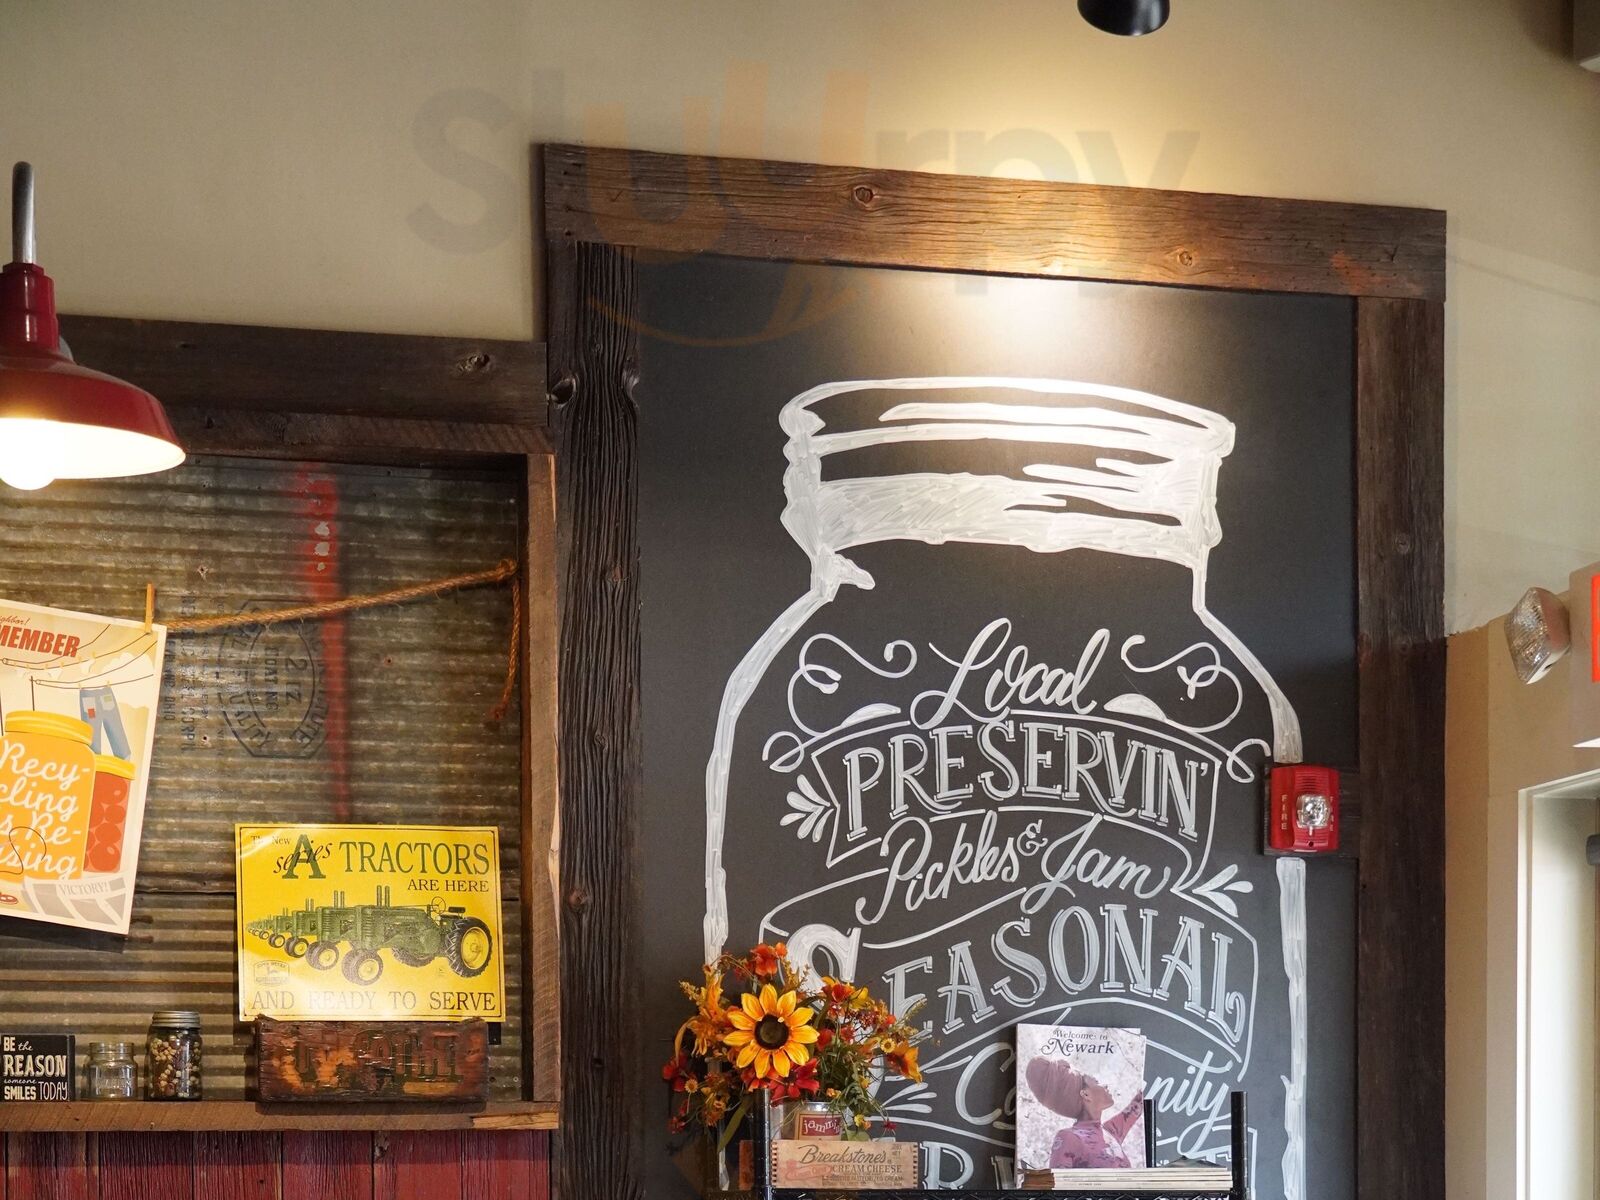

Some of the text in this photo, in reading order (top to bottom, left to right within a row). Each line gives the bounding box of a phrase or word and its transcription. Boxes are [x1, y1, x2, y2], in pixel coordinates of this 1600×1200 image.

[909, 617, 1110, 730] Local
[842, 720, 1208, 842] PRESERVIN'
[339, 841, 490, 875] TRACTORS
[855, 809, 1021, 925] Pickles
[1020, 812, 1173, 915] Jam
[58, 880, 109, 896] VICTORY!
[407, 879, 490, 893] ARE HERE
[251, 990, 496, 1011] AND READY TO SERVE
[3, 1036, 33, 1051] BE the
[1040, 1037, 1114, 1057] Newark
[3, 1054, 67, 1077] REASON
[4, 1081, 68, 1100] SMILES TODAY
[798, 1144, 886, 1165] Breakstone's
[832, 1164, 865, 1173] CREAM
[867, 1164, 903, 1173] CHEESE
